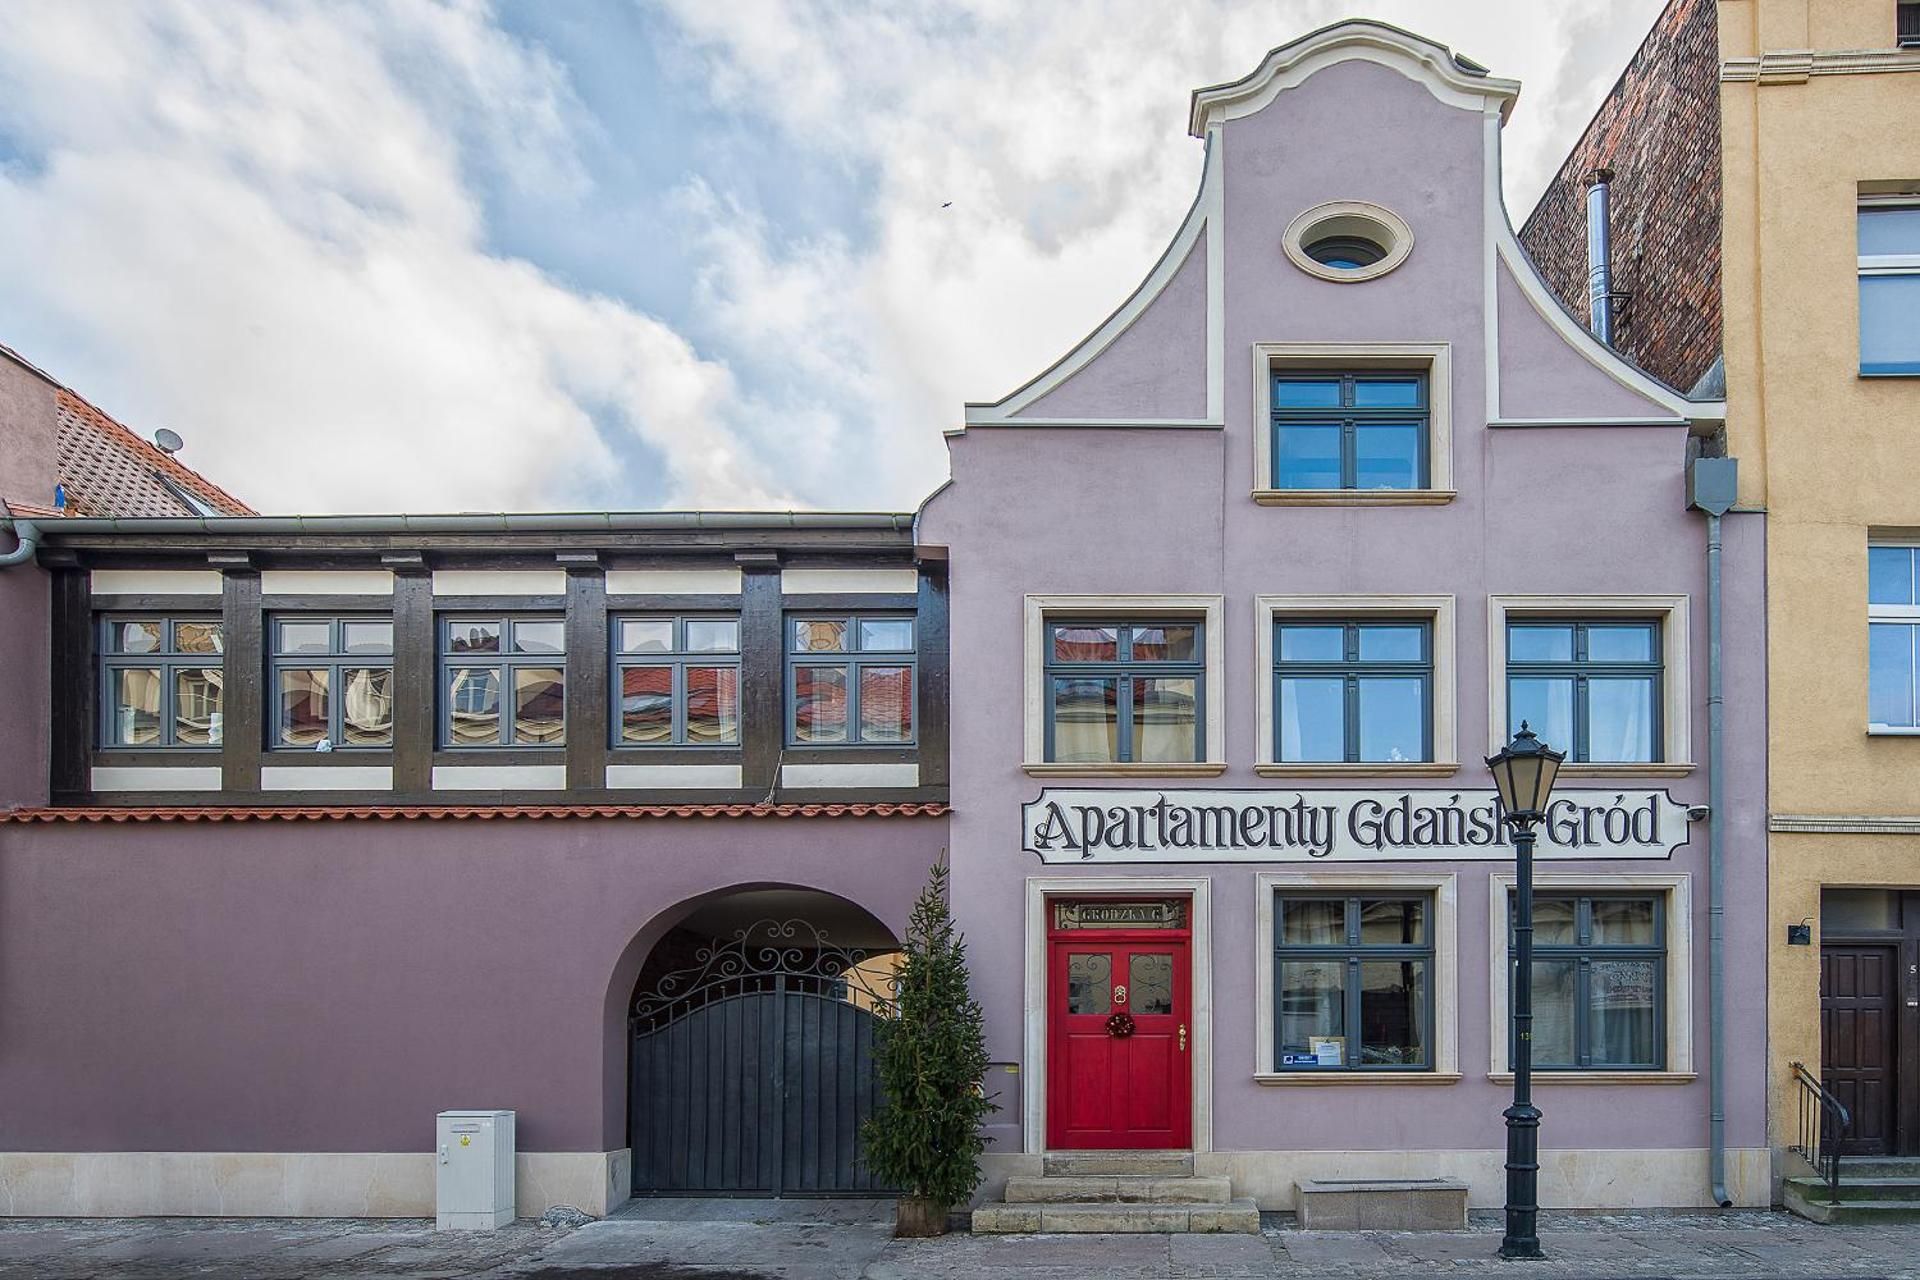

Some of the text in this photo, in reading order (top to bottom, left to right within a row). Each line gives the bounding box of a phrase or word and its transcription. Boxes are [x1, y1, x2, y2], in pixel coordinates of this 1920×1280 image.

[1033, 792, 1339, 860] Apartamenty
[1546, 793, 1664, 850] Gród
[1082, 909, 1146, 920] GRODZKA
[1909, 964, 1917, 973] 5
